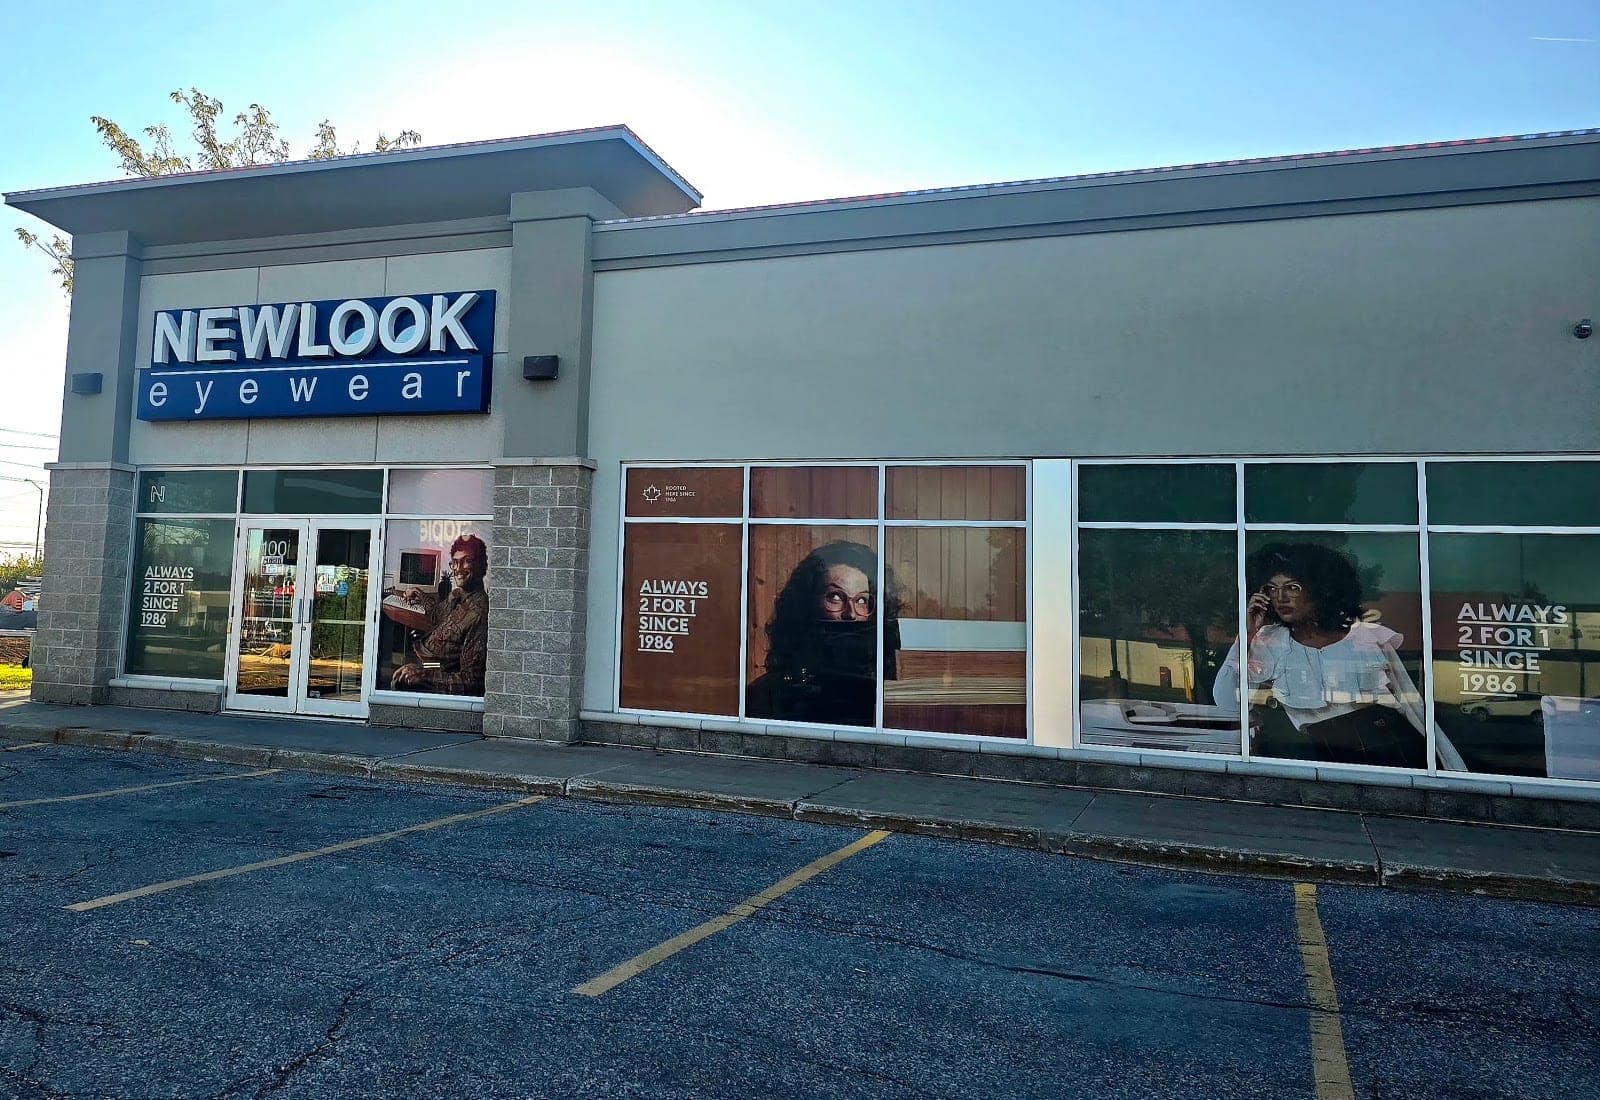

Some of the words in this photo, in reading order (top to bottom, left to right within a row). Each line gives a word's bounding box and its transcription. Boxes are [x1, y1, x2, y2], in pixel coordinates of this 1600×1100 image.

[153, 292, 479, 365] NEWLOOK
[149, 370, 471, 414] eyewear
[144, 565, 194, 579] ALWAYS
[143, 581, 151, 593] 2
[153, 581, 177, 594] FOR
[179, 582, 185, 594] 1
[639, 579, 709, 596] ALWAYS
[142, 596, 179, 610] SINCE
[639, 597, 649, 612] 2
[653, 598, 686, 613] FOR
[688, 599, 696, 614] 1
[141, 611, 167, 625] 1986
[1457, 602, 1568, 624] ALWAYS
[639, 616, 689, 632] SINCE
[639, 634, 674, 650] 1986
[1458, 626, 1473, 643] 2
[1480, 627, 1535, 646] FOR
[1538, 629, 1549, 646] 1
[1459, 650, 1540, 670] SINCE
[1459, 673, 1517, 693] 1986
